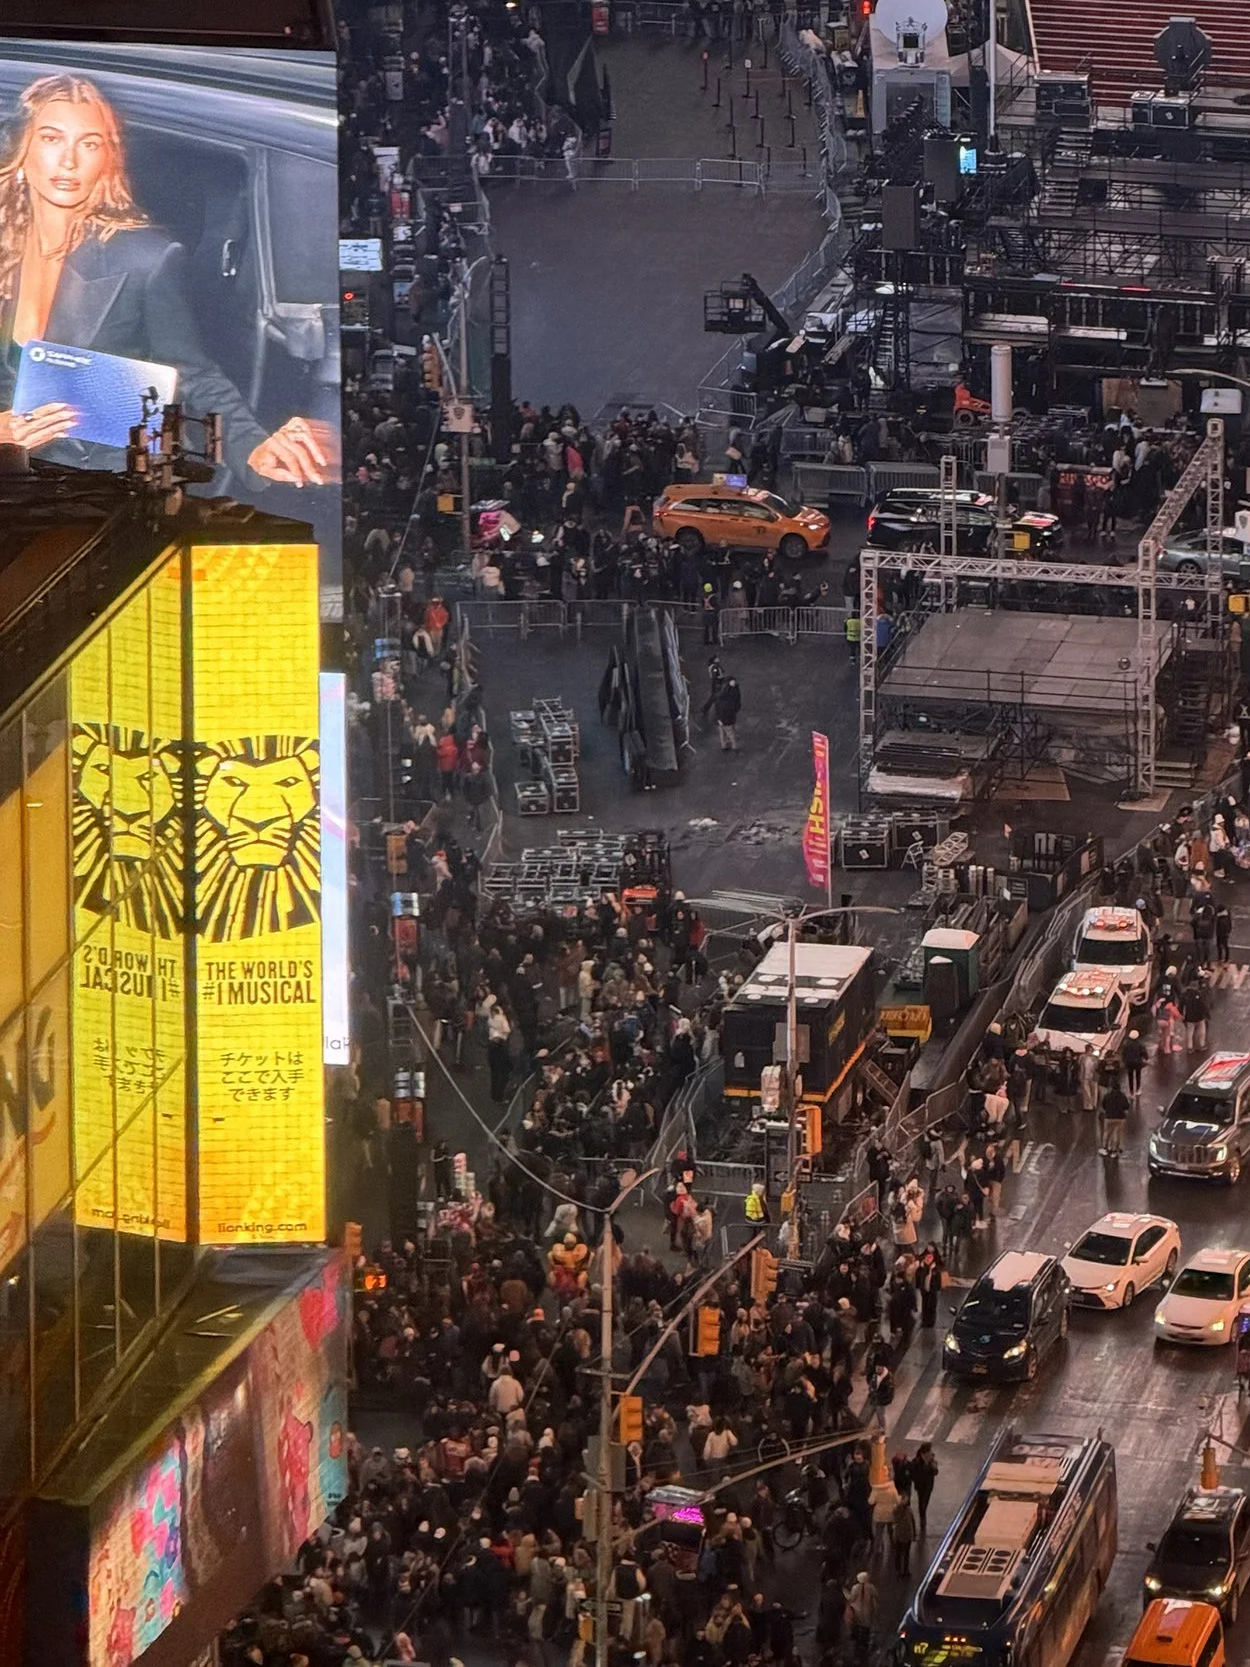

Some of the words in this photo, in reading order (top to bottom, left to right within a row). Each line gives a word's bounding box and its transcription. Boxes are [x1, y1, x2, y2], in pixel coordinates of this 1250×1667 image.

[204, 961, 237, 981] THE
[241, 959, 314, 980] WORLD'S
[202, 982, 223, 1006] #1
[227, 980, 317, 1006] MUSICAL
[219, 1051, 305, 1067] チケットは
[221, 1068, 305, 1085] ここで入手
[228, 1086, 296, 1102] できます
